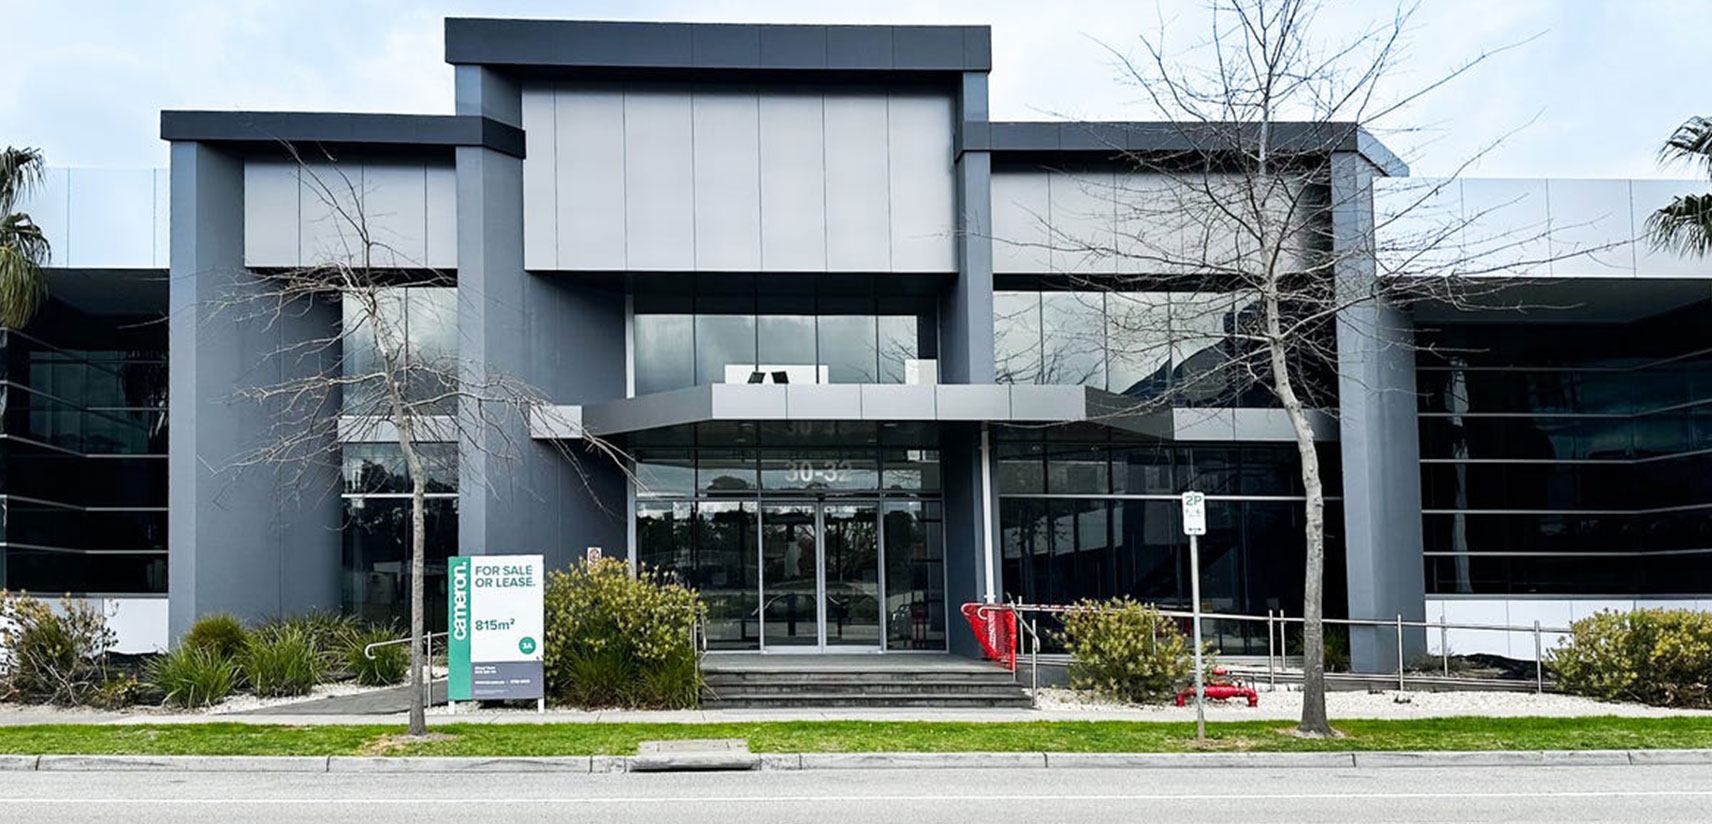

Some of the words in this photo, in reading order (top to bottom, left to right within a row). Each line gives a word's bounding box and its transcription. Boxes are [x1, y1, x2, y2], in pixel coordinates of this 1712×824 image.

[785, 461, 851, 481] 30-32
[1185, 495, 1202, 505] 2P
[475, 565, 500, 576] FOR
[502, 565, 533, 576] SALE
[475, 577, 493, 588] OR
[496, 577, 536, 588] LEASE.
[453, 561, 467, 641] cameron.
[475, 618, 515, 631] 815m²
